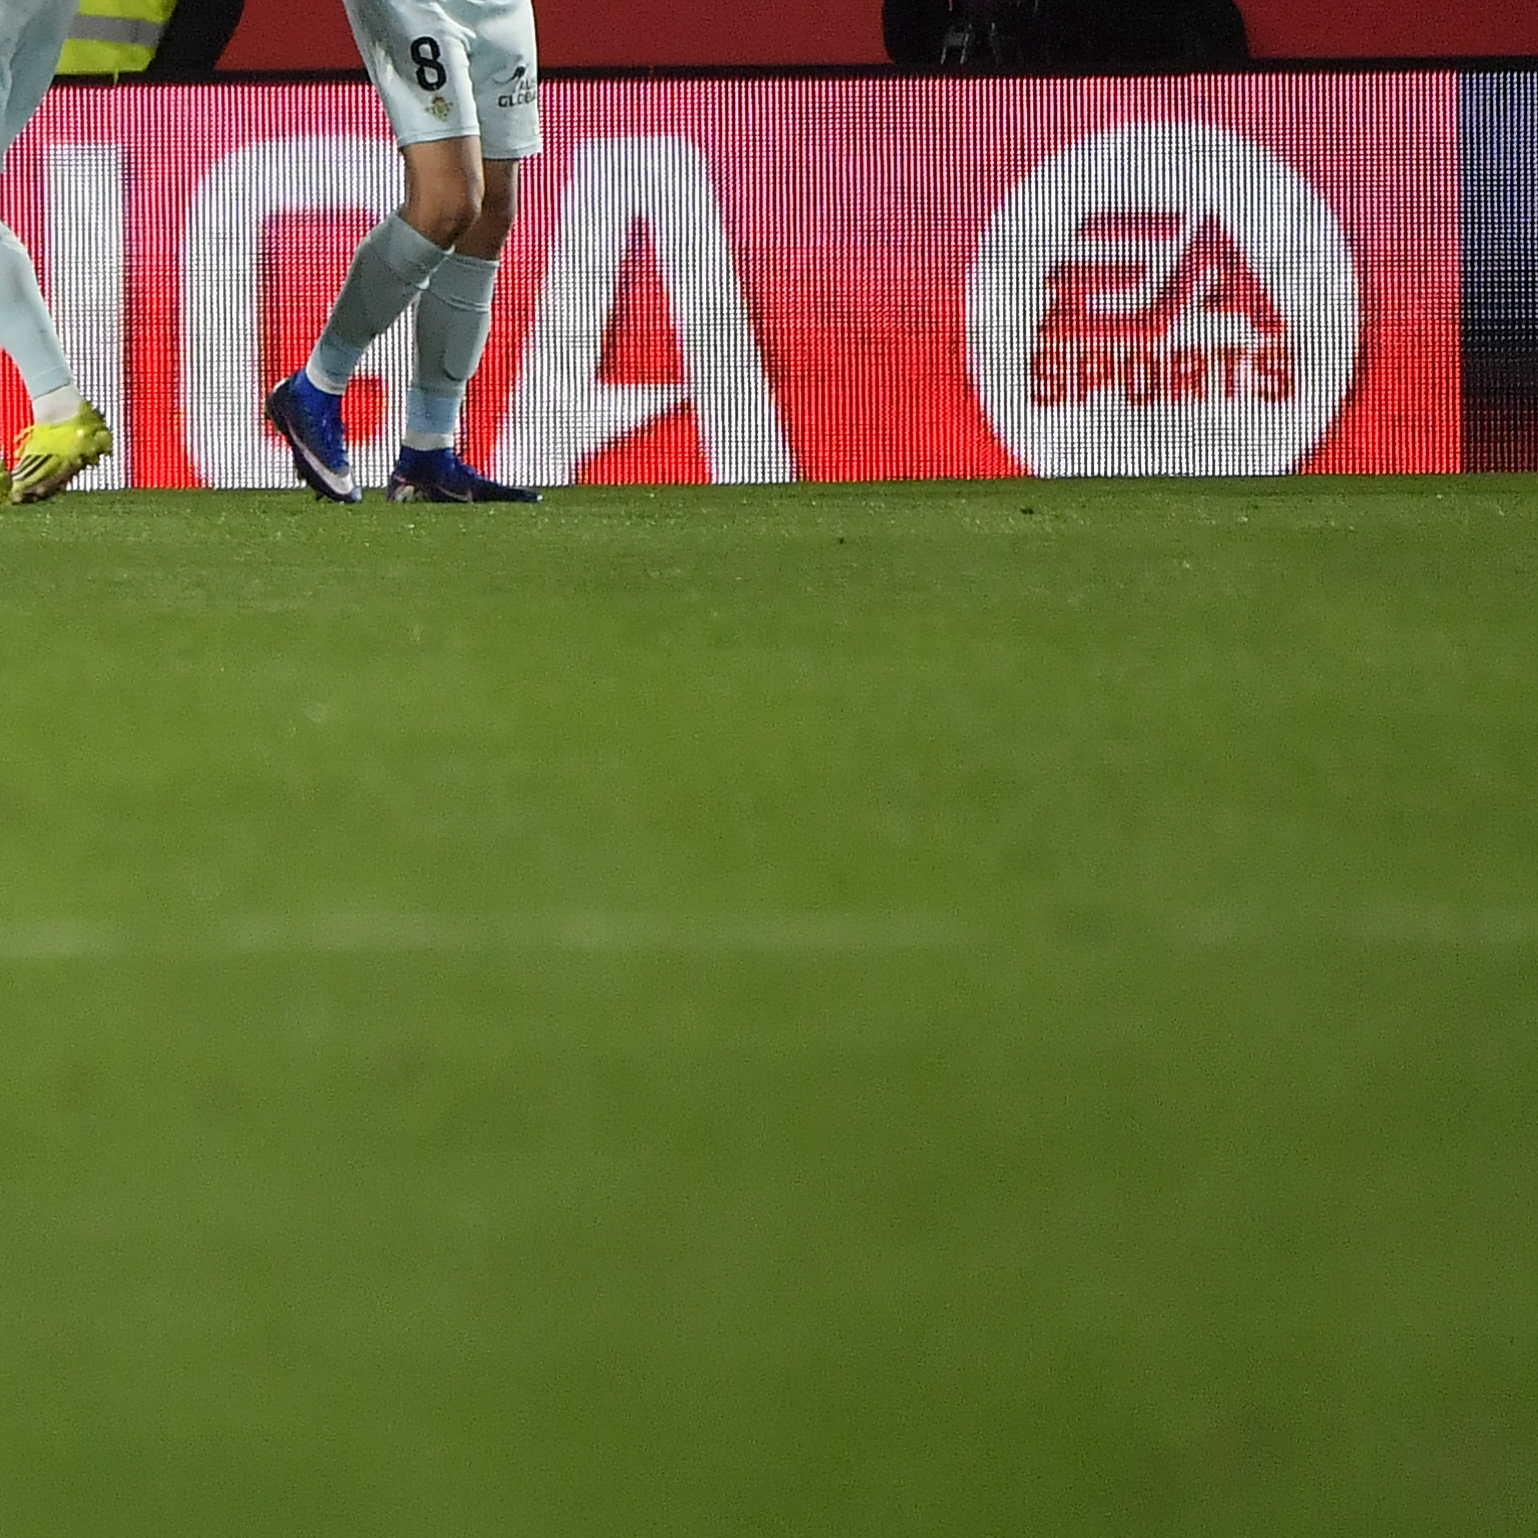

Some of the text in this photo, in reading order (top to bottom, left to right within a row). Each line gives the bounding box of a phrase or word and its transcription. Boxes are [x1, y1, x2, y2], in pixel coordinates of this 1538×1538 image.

[411, 37, 446, 91] 8
[1035, 208, 1295, 340] EA
[1028, 348, 1293, 407] SPORTS
